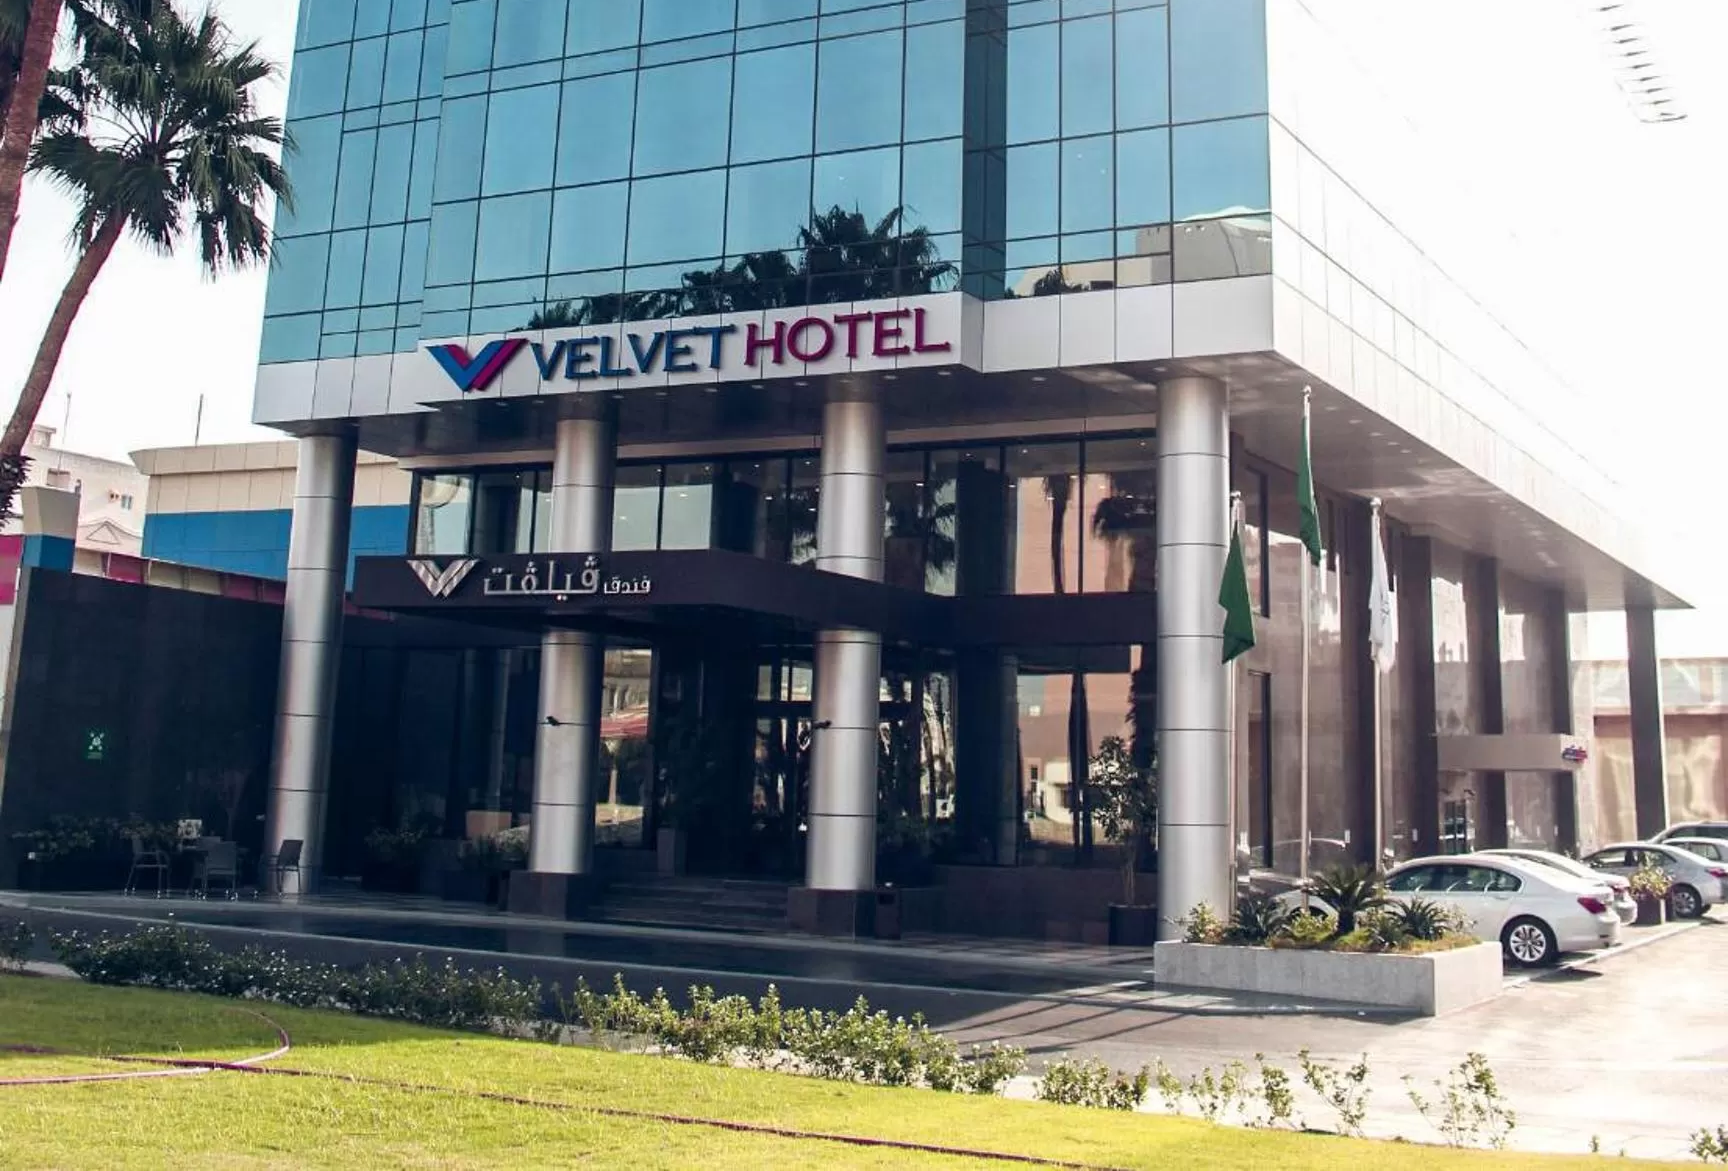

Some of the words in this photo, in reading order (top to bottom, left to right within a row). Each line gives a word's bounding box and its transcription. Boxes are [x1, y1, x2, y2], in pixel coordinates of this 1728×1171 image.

[529, 324, 737, 382] VELVET
[744, 308, 952, 367] HOTEL
[604, 576, 651, 594] فندق
